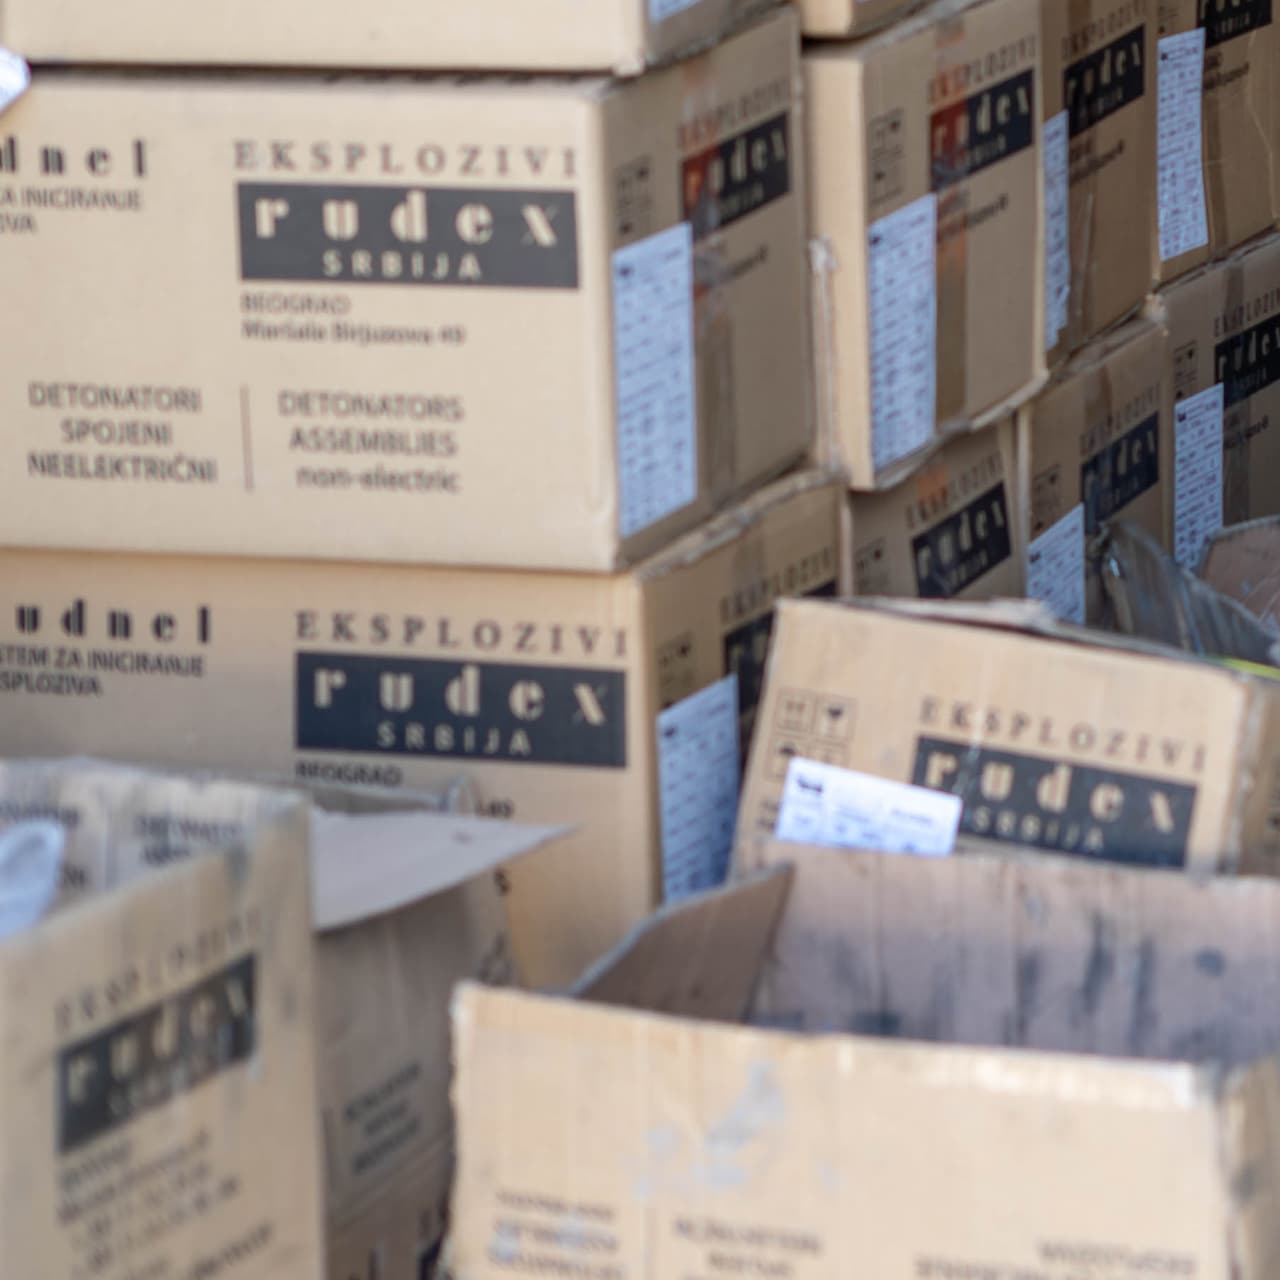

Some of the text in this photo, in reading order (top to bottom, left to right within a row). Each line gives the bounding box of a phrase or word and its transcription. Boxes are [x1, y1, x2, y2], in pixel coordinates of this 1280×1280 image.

[232, 138, 578, 180] EKSPLOZIVI
[254, 190, 558, 248] rudex
[322, 249, 483, 282] SRBIJA
[27, 381, 202, 414] DETONATORI
[27, 450, 217, 485] NEELEKTRIČNI
[15, 597, 212, 644] udnel
[295, 610, 629, 658] EKSPLOZIVI
[313, 663, 608, 726] rudex
[377, 723, 533, 754] SRBIJA
[919, 696, 1207, 772] EKSPLOZIVI
[924, 748, 1176, 835] rudex
